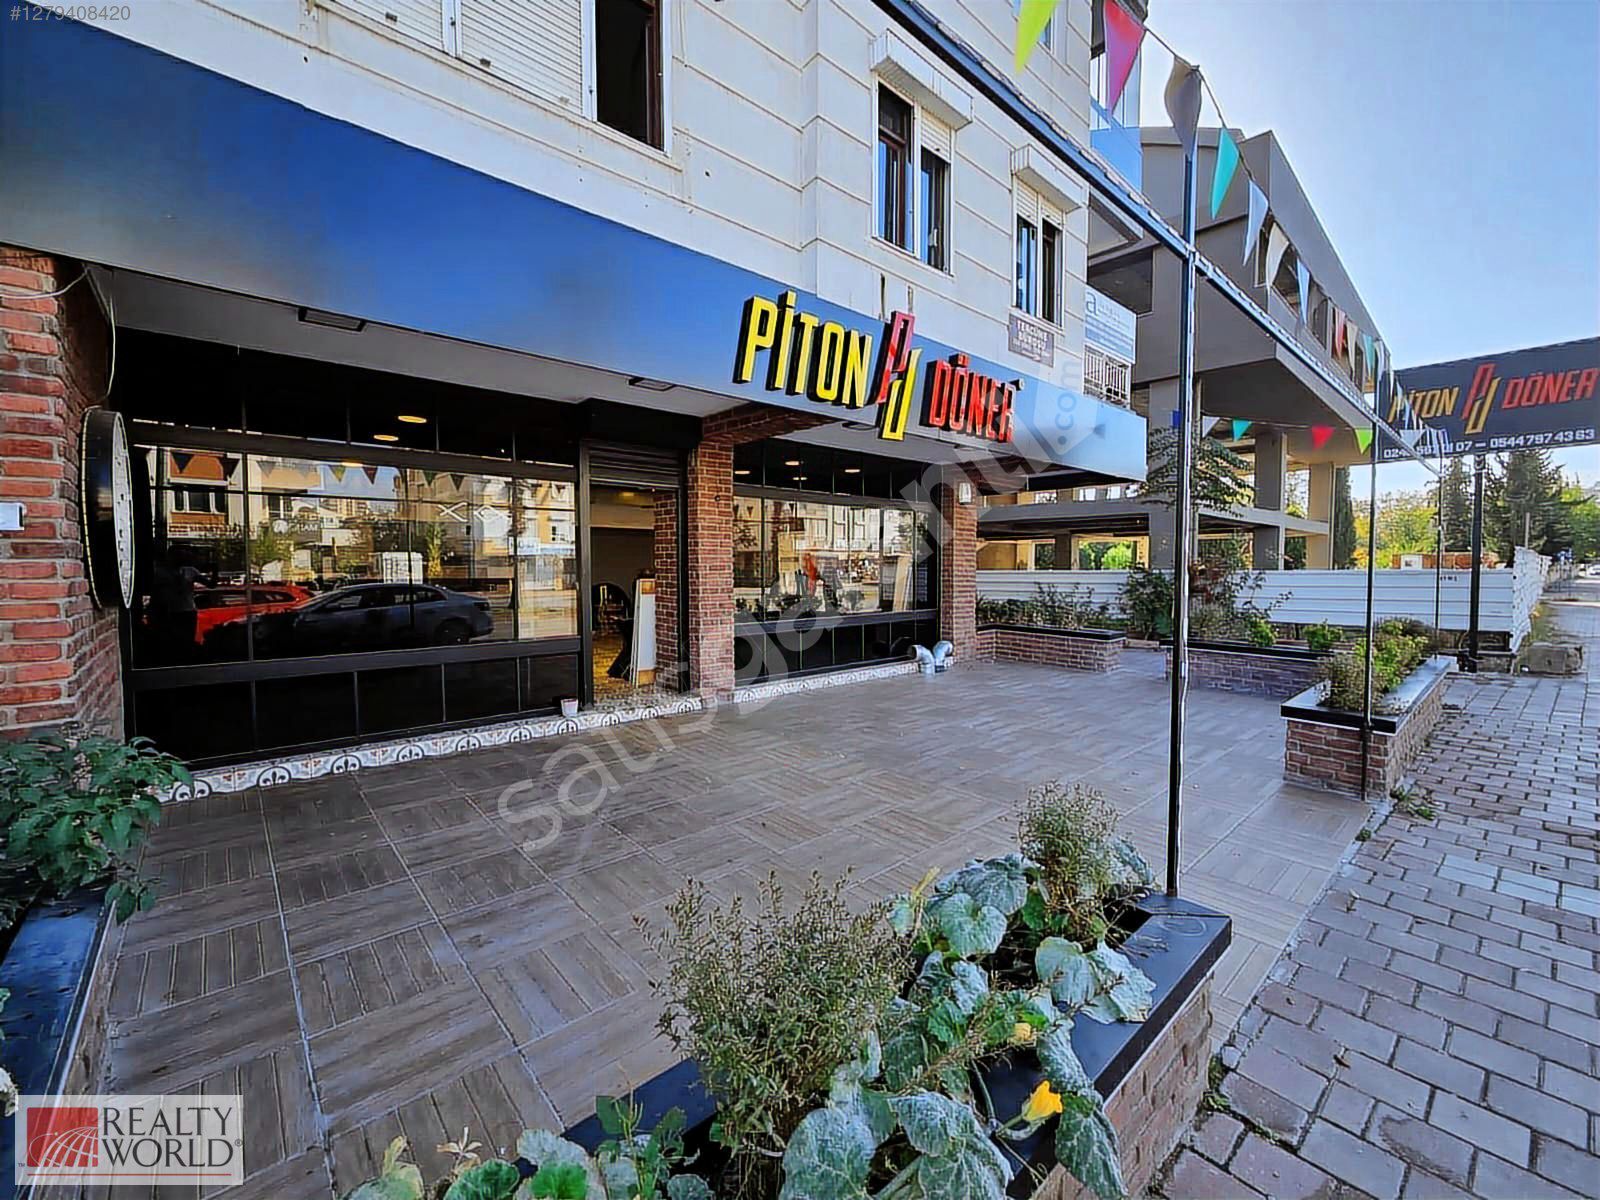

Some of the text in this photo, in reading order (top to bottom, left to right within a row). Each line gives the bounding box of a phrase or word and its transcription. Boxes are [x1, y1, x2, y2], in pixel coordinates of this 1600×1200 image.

[1501, 367, 1600, 409] DÖNER
[1383, 447, 1411, 459] 024
[1455, 440, 1473, 453] 07
